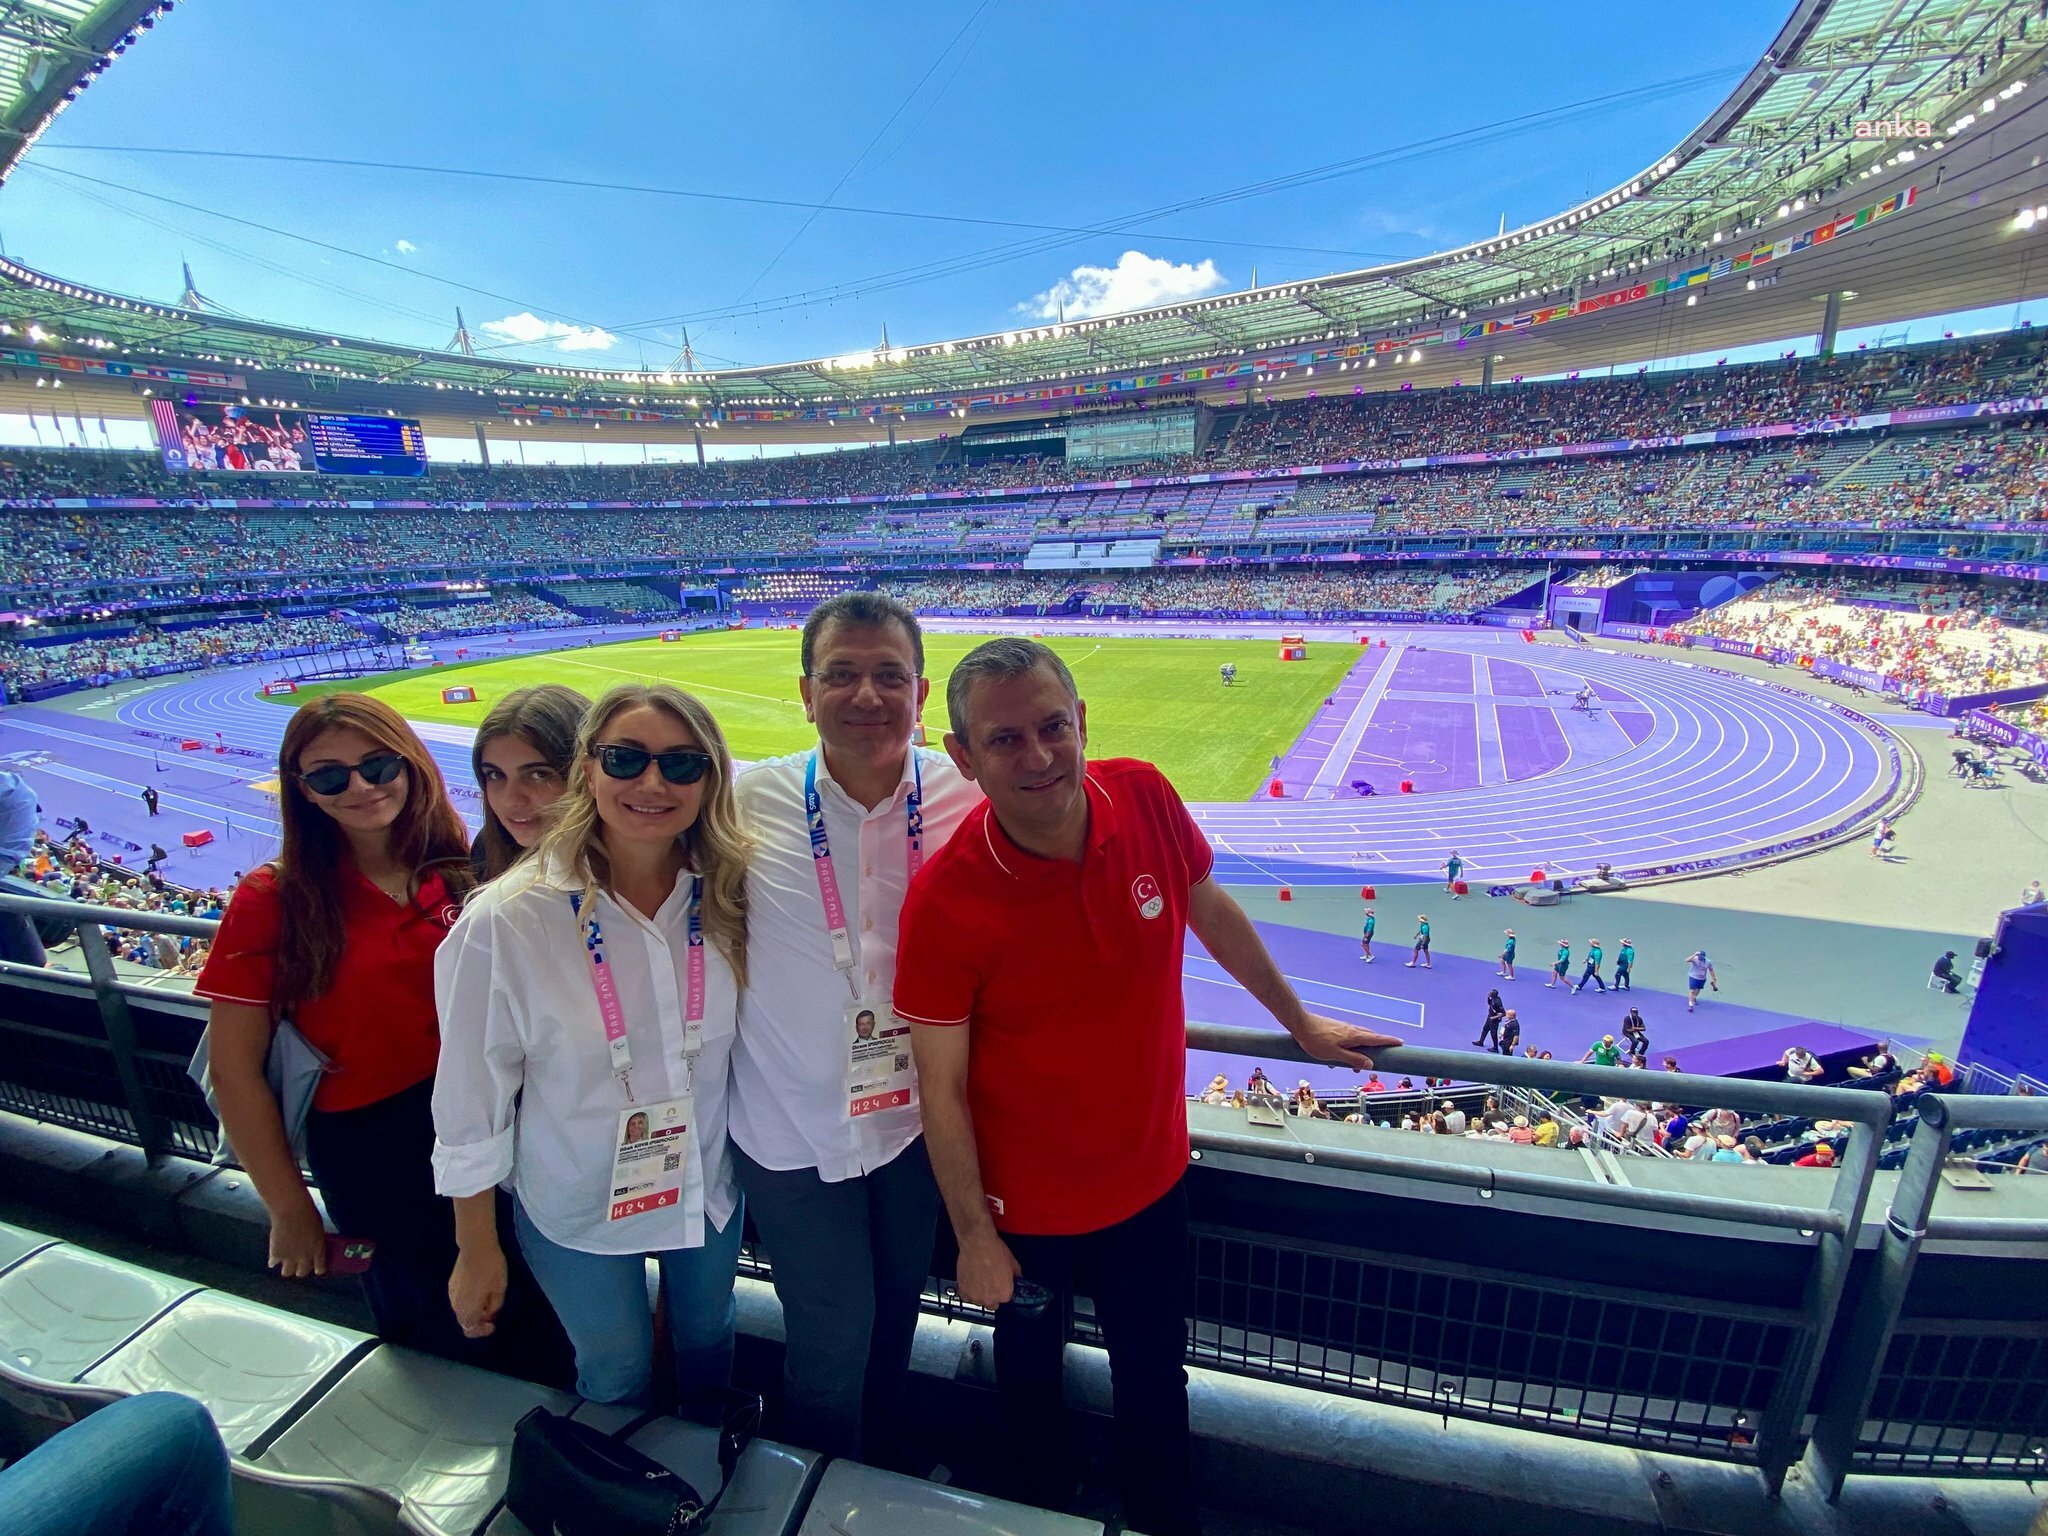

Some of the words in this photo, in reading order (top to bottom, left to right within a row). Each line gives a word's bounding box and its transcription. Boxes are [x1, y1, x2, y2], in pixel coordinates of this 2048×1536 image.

[1907, 412, 1931, 420] PARIS
[1934, 409, 1957, 417] 2024
[1616, 627, 1638, 635] PARIS
[1720, 642, 1741, 651] PARIS
[1971, 715, 1993, 732] PARIS
[1992, 725, 2013, 742] 2024
[820, 862, 833, 894] PARIS
[827, 896, 839, 925] 2024
[605, 1002, 620, 1035] PARIS
